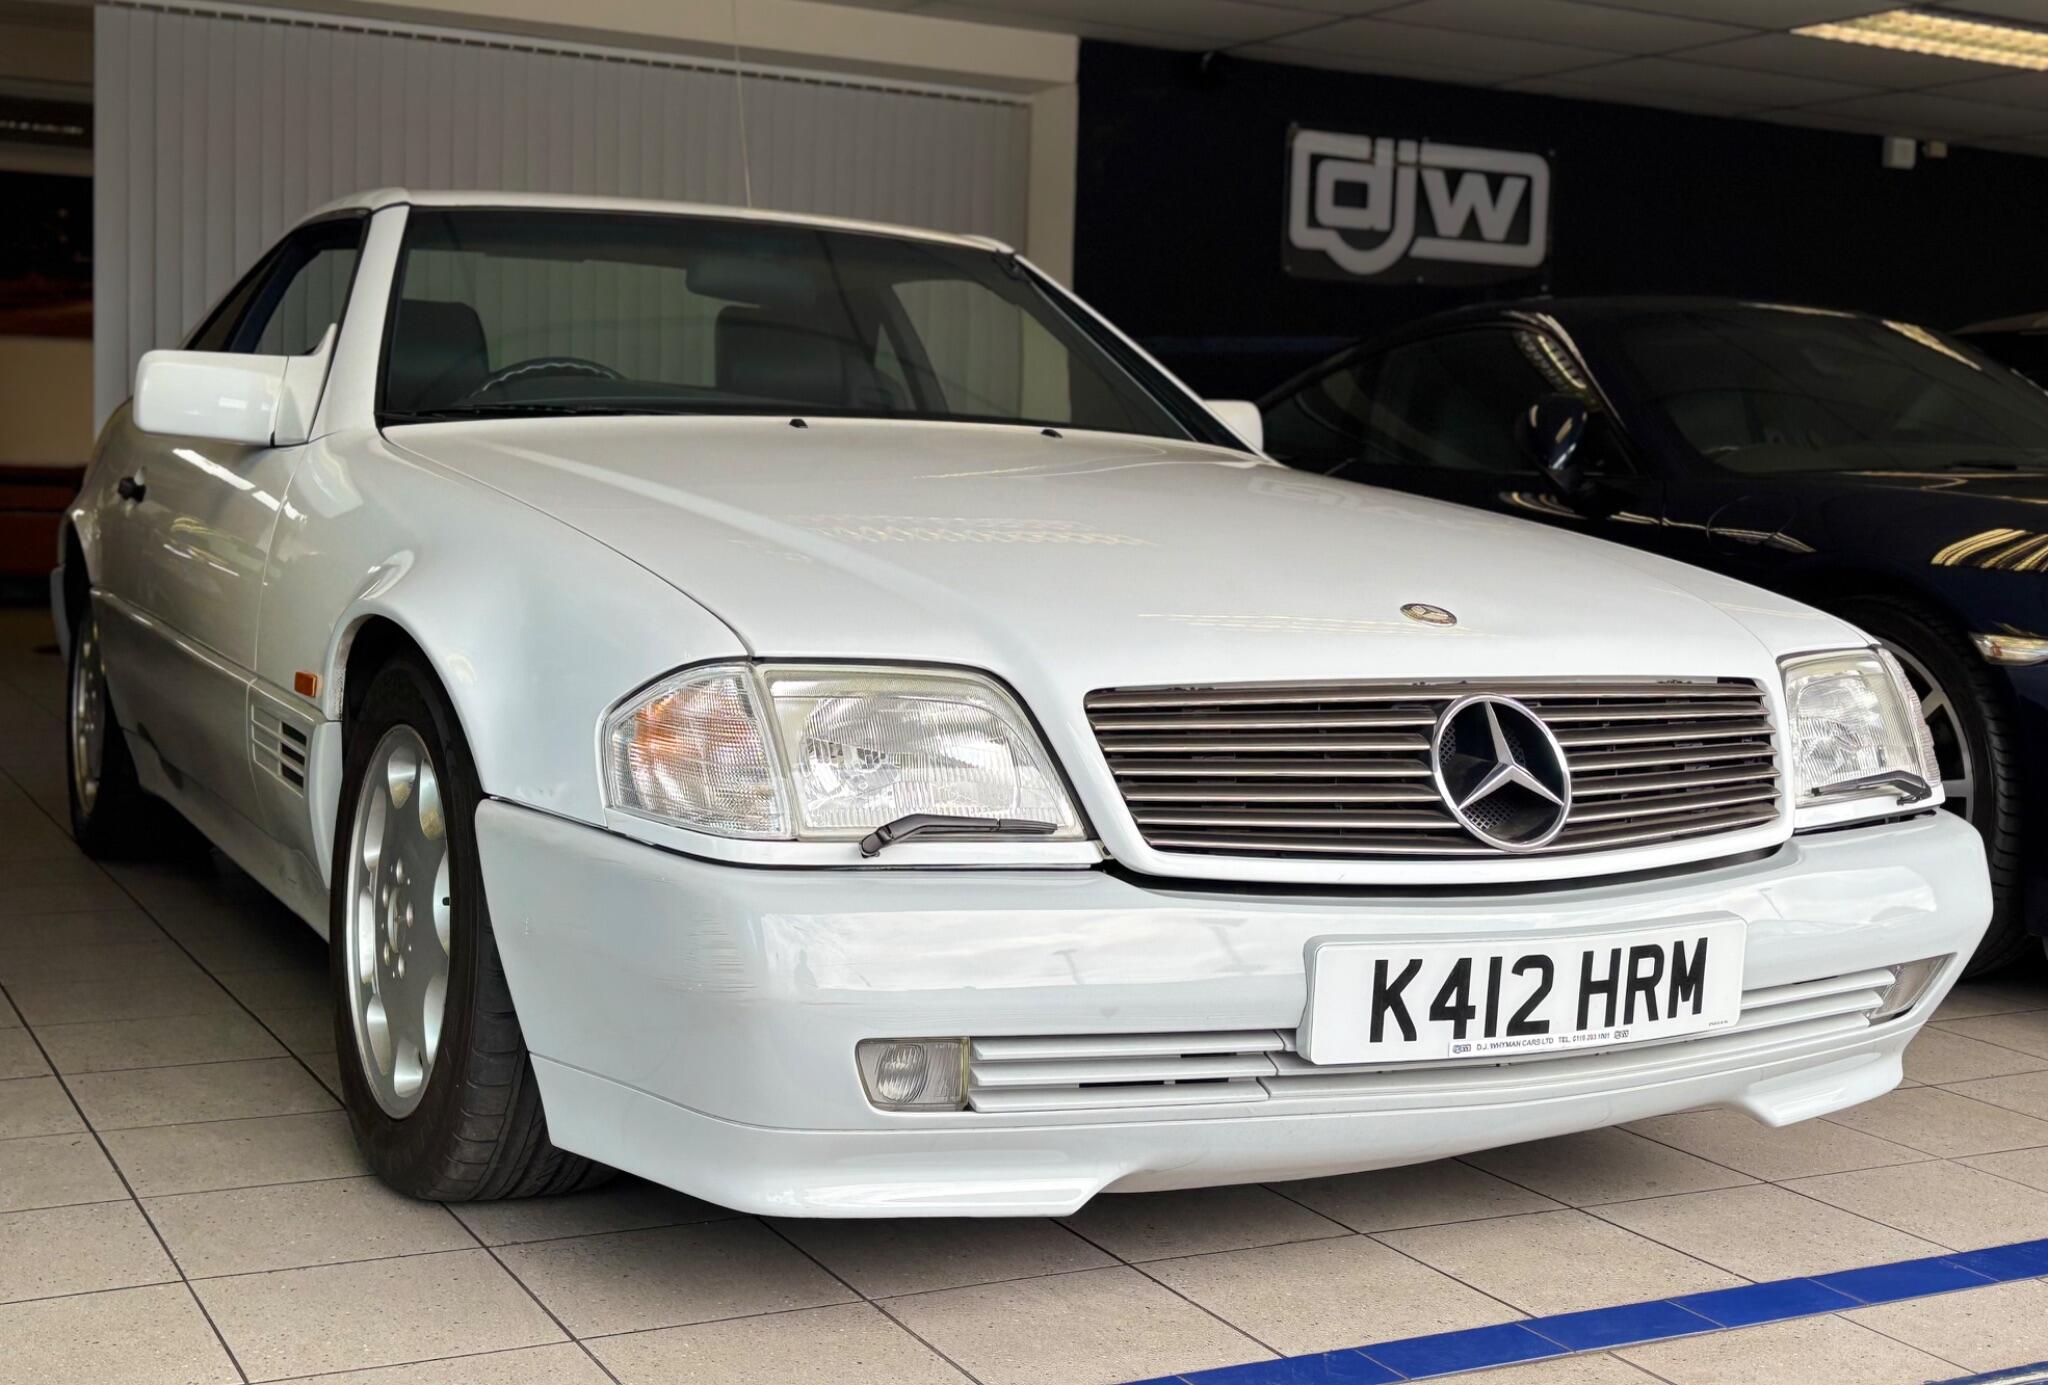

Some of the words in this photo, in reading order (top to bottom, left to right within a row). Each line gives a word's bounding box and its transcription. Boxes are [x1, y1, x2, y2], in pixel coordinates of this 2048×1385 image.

[1306, 133, 1534, 275] djw
[1369, 953, 1555, 1043] K412
[1576, 937, 1709, 1031] HRM
[1490, 1041, 1521, 1050] WHYMAN
[1522, 1038, 1541, 1047] CARS
[1541, 1037, 1554, 1045] LTD
